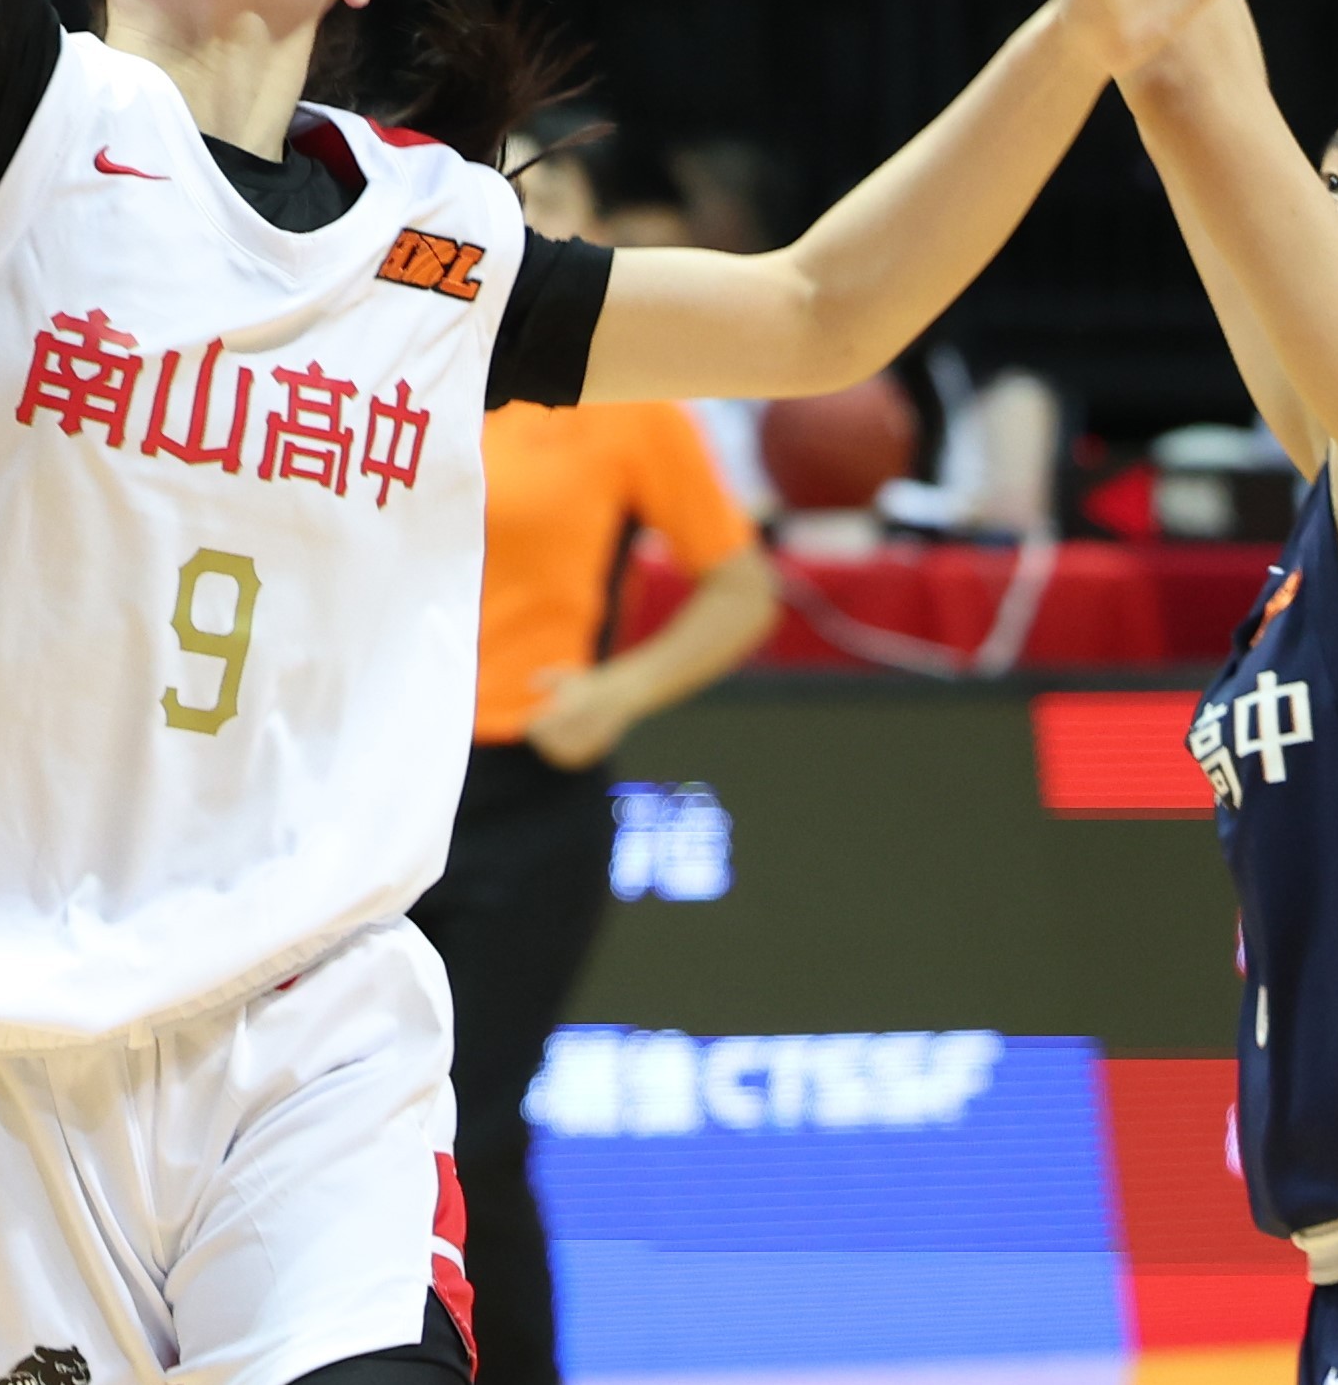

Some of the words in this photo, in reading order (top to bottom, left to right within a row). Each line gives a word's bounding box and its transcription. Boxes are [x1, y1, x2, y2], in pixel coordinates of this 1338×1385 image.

[15, 307, 431, 510] 南山高中
[160, 547, 262, 735] 9
[1188, 670, 1314, 811] 高中
